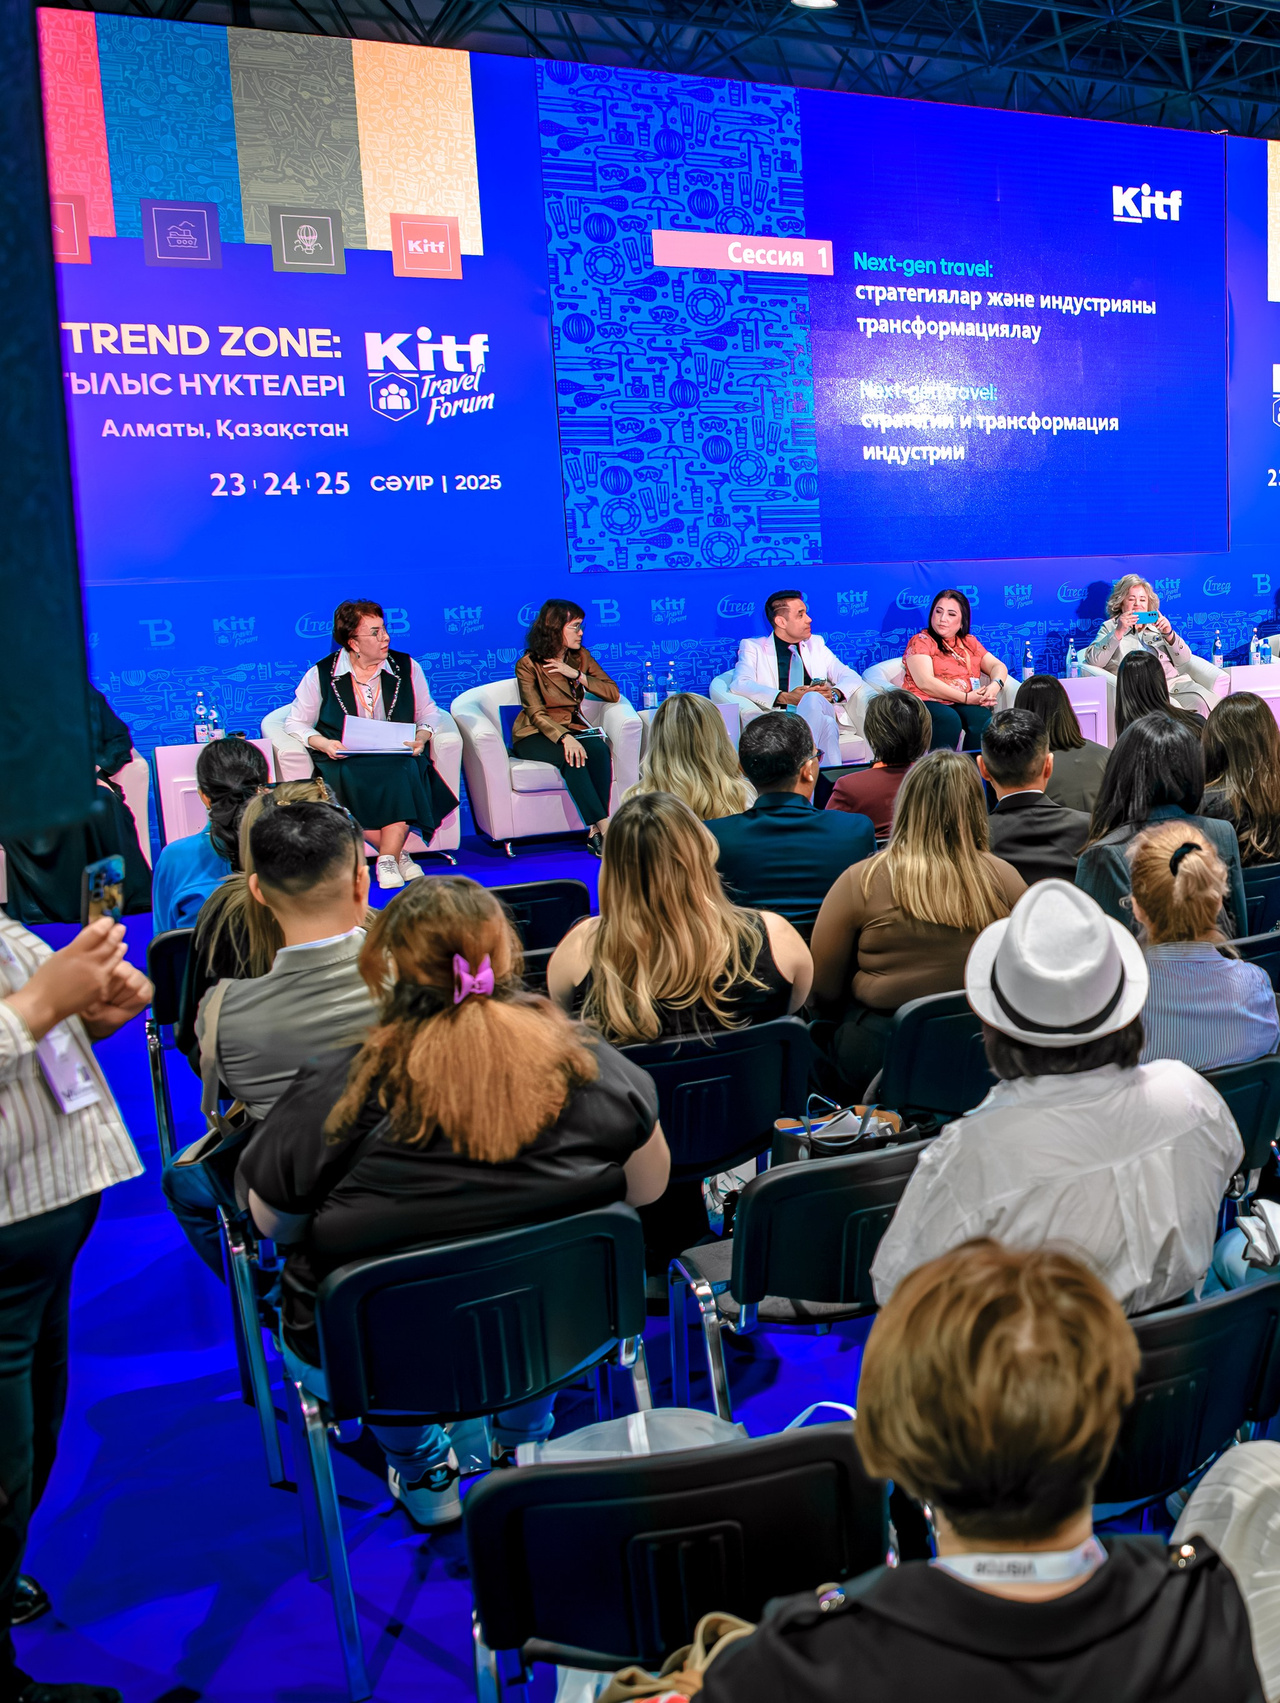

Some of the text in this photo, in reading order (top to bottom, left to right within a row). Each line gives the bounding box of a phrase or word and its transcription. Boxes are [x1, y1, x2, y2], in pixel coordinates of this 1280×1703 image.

[1112, 183, 1182, 222] Kitf
[407, 239, 445, 254] Kitf
[727, 241, 828, 269] Сессия 1
[853, 251, 994, 278] Next-gen travel:
[855, 283, 1156, 317] стратегиялар және индустрияны
[60, 322, 342, 359] TREND ZONE:
[856, 315, 1042, 345] трансформациялау
[364, 326, 490, 374] Kitf
[64, 371, 345, 397] ЫЛЫС НҮКТЕЛЕРІ
[420, 363, 486, 399] Travel
[860, 380, 998, 403] Next-gen travel:
[426, 392, 495, 426] Forum
[101, 418, 349, 440] Алматы, Қазақстан
[861, 412, 1119, 435] стратегии и трансформация
[863, 444, 965, 465] индустрии
[369, 474, 434, 492] СӘУІР
[455, 474, 502, 491] 2025
[1004, 583, 1033, 596] Kitf
[1155, 577, 1181, 590] Kitf
[651, 597, 685, 611] Kitf
[837, 590, 868, 603] Kitf
[212, 615, 256, 632] Kitf
[443, 605, 483, 620] Kitf
